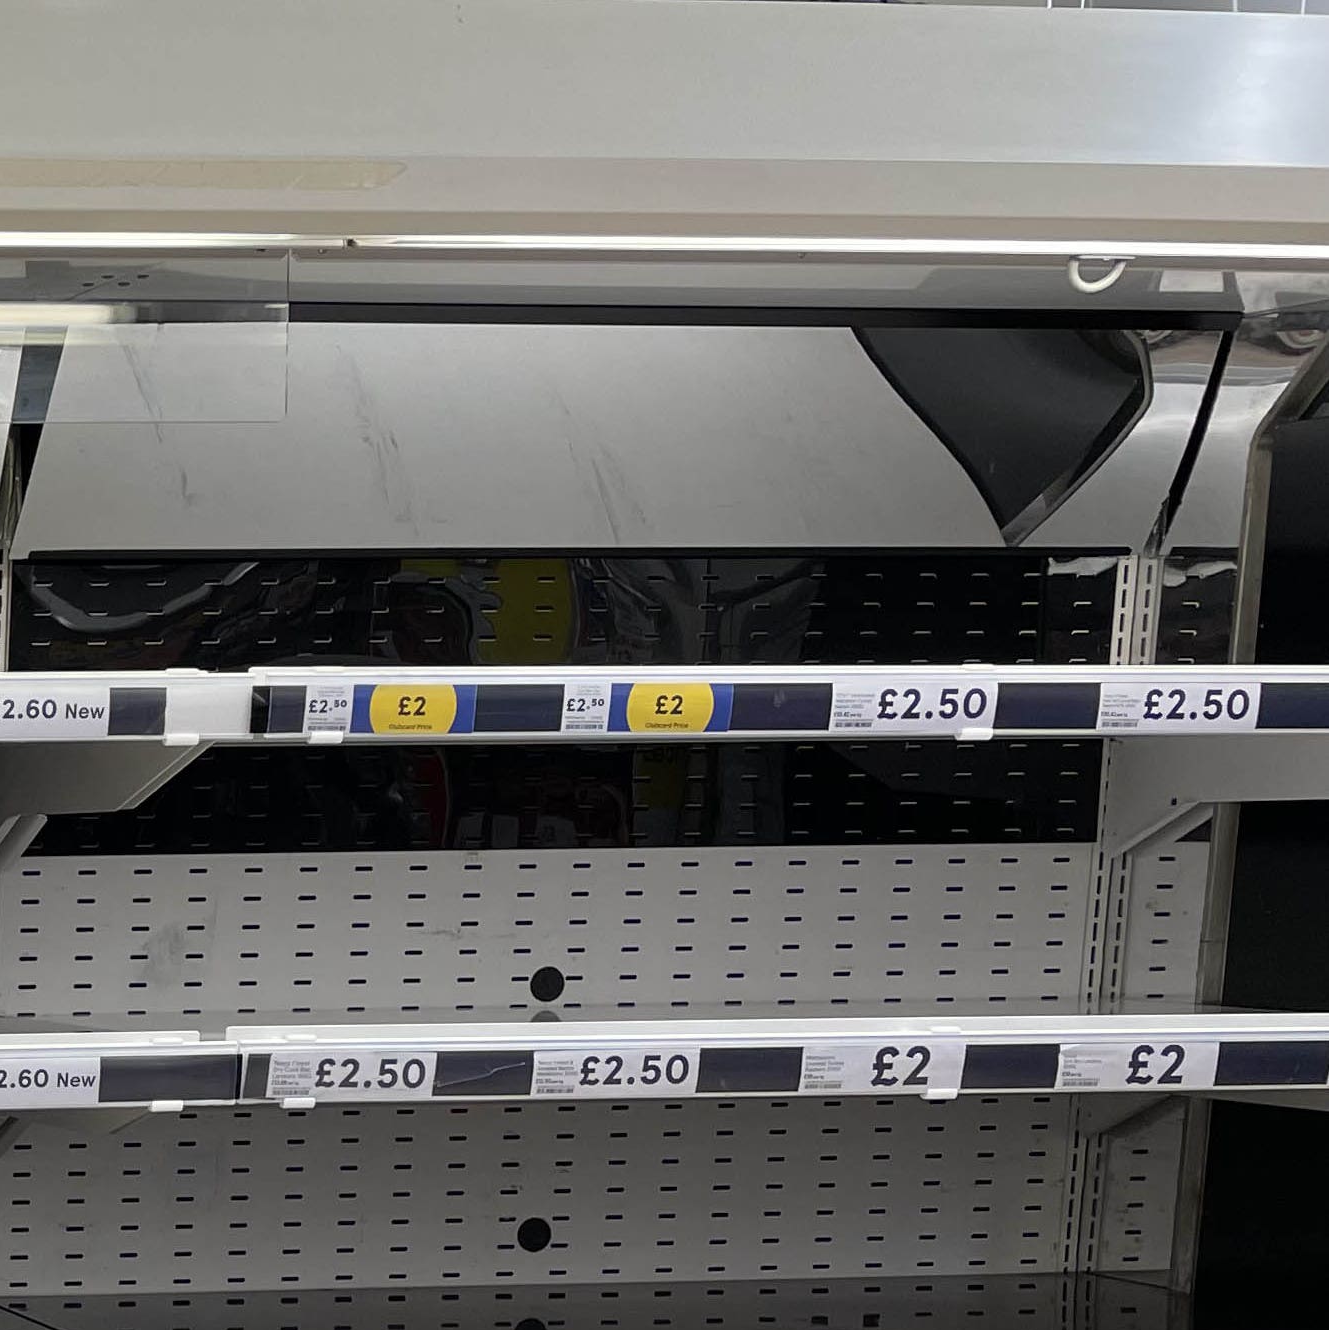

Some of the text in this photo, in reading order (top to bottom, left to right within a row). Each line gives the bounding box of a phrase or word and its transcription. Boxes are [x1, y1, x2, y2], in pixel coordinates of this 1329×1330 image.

[66, 704, 104, 719] New
[309, 700, 347, 713] £2.50
[398, 697, 425, 716] £2
[567, 699, 604, 712] £2.50
[655, 695, 682, 714] £2
[877, 689, 986, 719] £2.50
[1143, 689, 1249, 720] £2.50
[315, 1059, 425, 1088] £2.50
[579, 1055, 689, 1085] £2.50
[871, 1046, 930, 1086] £2
[1125, 1045, 1185, 1084] £2
[57, 1073, 96, 1087] New
